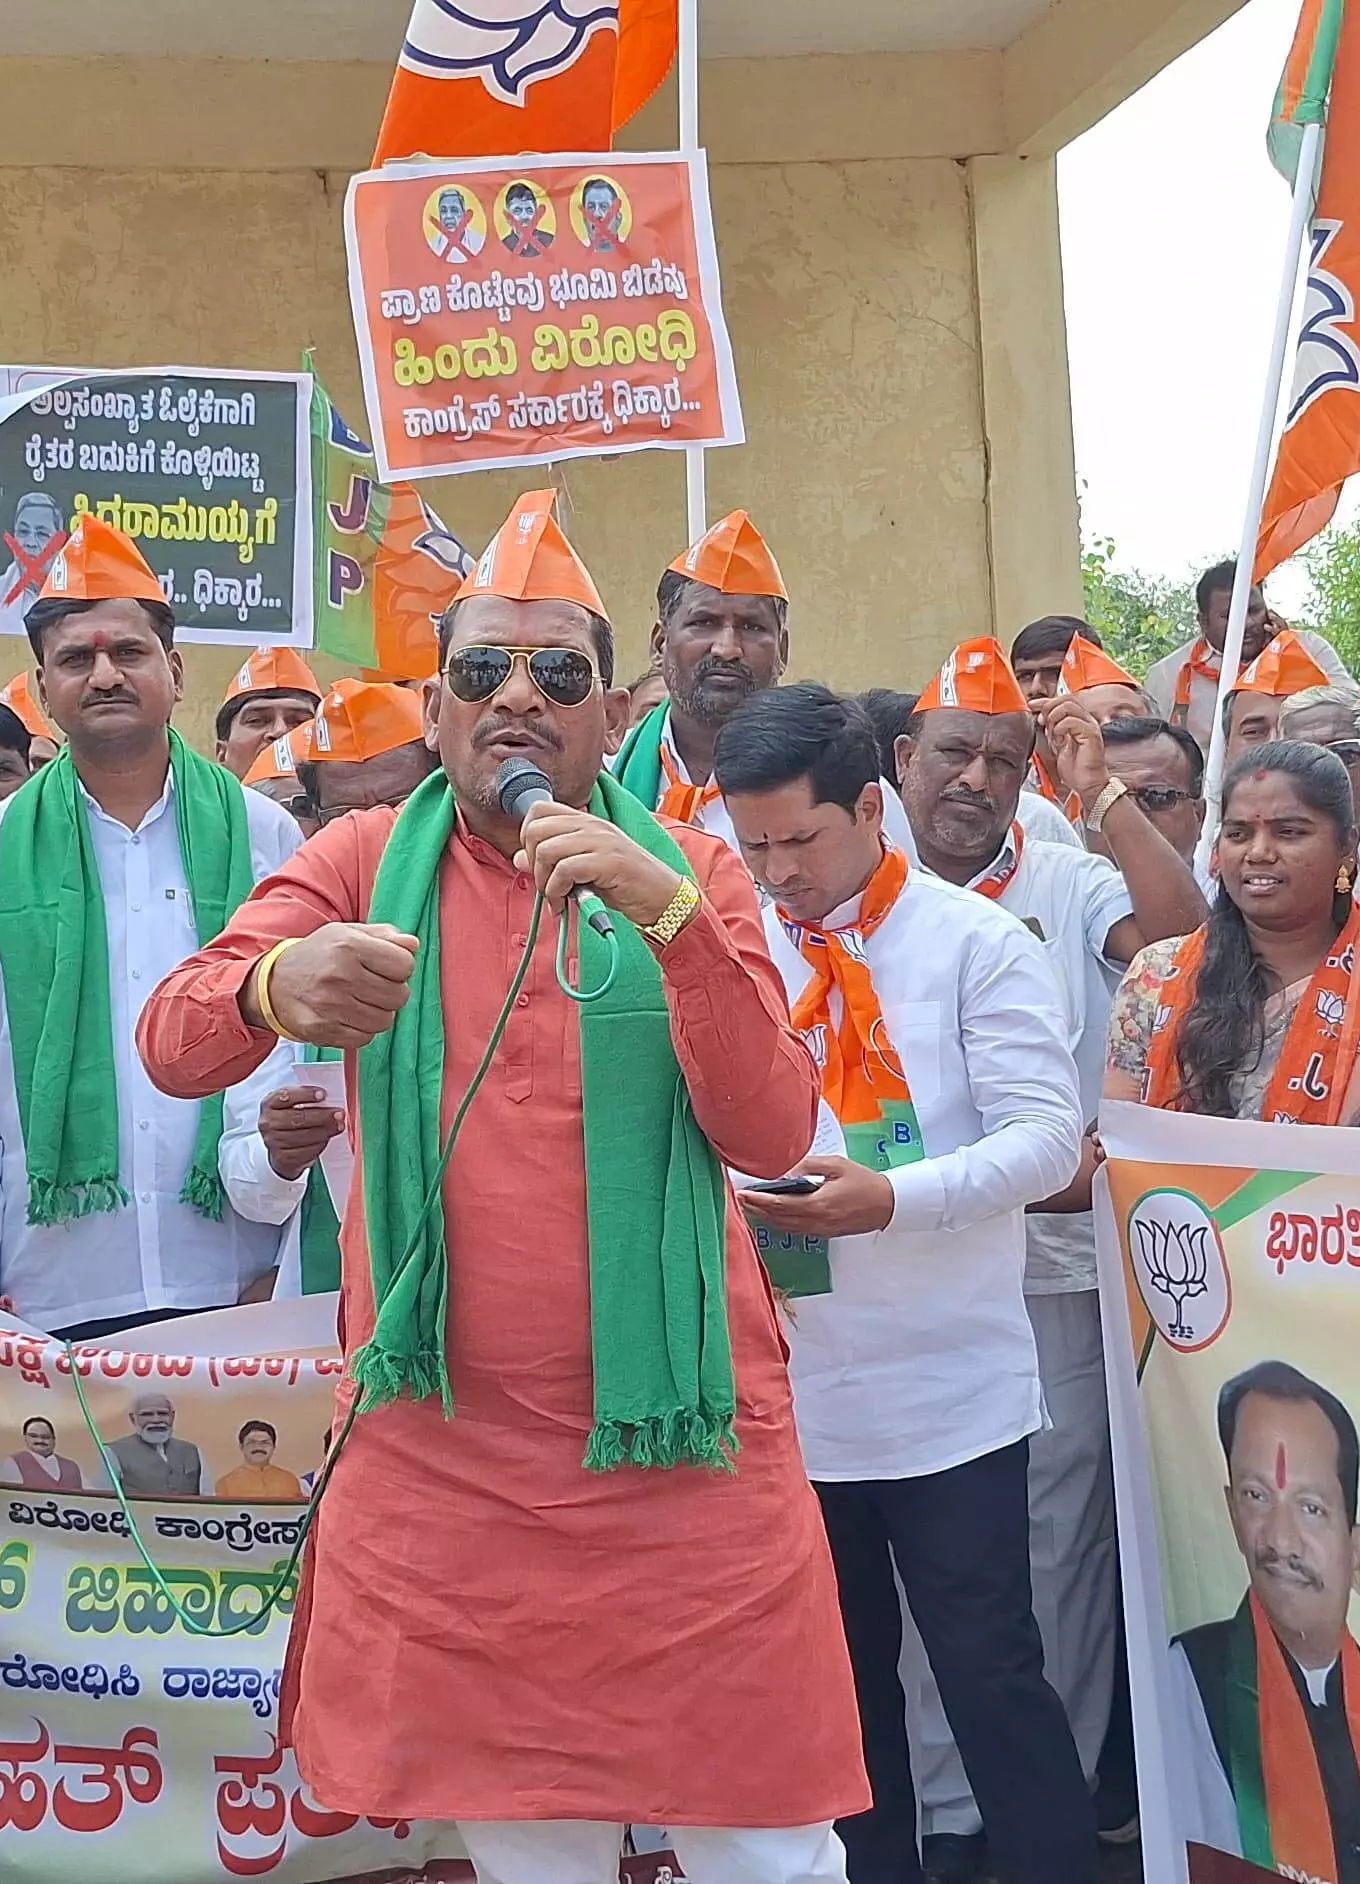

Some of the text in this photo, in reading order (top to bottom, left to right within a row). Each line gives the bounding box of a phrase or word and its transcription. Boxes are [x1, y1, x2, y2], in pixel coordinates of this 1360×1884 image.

[381, 287, 442, 324] ಪ್ರಾಣ
[549, 267, 617, 311] ಭೂಮಿ
[393, 309, 697, 386] ಹಿಂದು ವಿರೋಧಿ
[403, 395, 501, 442] ಕಾಂಗ್ರೆಸ್
[507, 380, 612, 435] ಸರ್ಕಾರಕ್ಕೆ
[25, 433, 74, 482] ರೈತರ
[79, 438, 156, 474] ಬದುಕಿಗೆ
